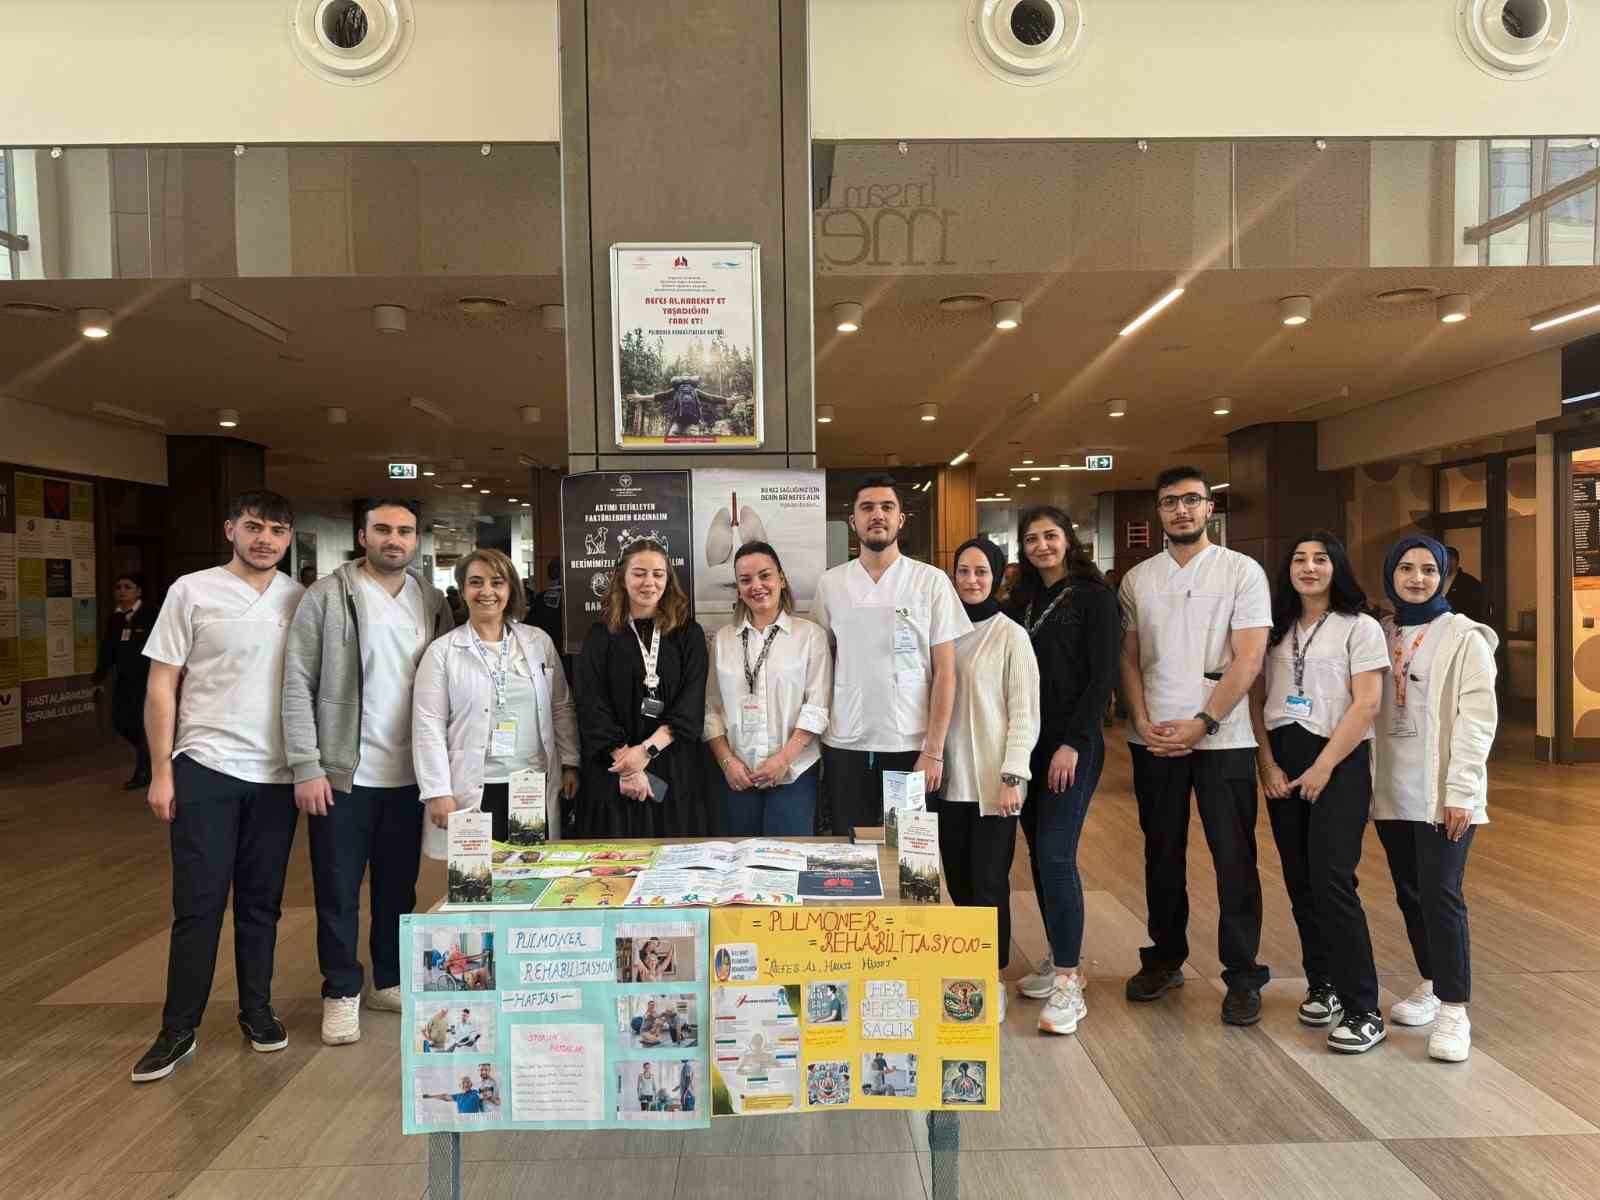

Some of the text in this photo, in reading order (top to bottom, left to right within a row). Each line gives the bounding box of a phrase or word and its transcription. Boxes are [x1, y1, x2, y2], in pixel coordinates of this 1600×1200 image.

[595, 503, 618, 512] ASTIMI
[769, 909, 880, 932] PULMONER
[820, 929, 980, 955] REHABİLİTASYON
